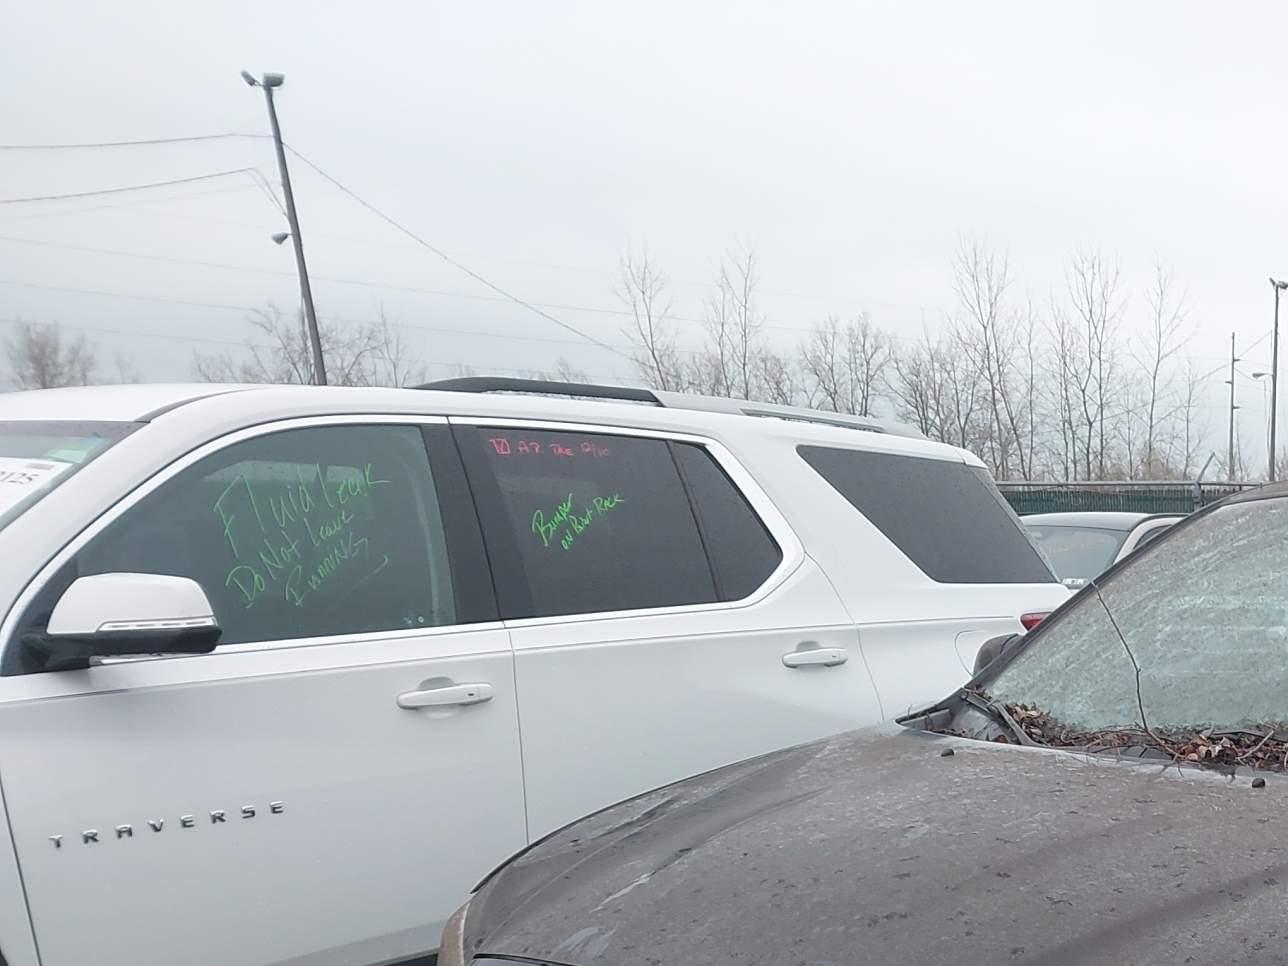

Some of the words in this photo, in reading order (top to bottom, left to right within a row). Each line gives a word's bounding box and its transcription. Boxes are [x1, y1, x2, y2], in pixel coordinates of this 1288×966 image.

[225, 565, 264, 608] Do
[258, 530, 301, 581] Not
[48, 800, 285, 849] TRAVERSE
